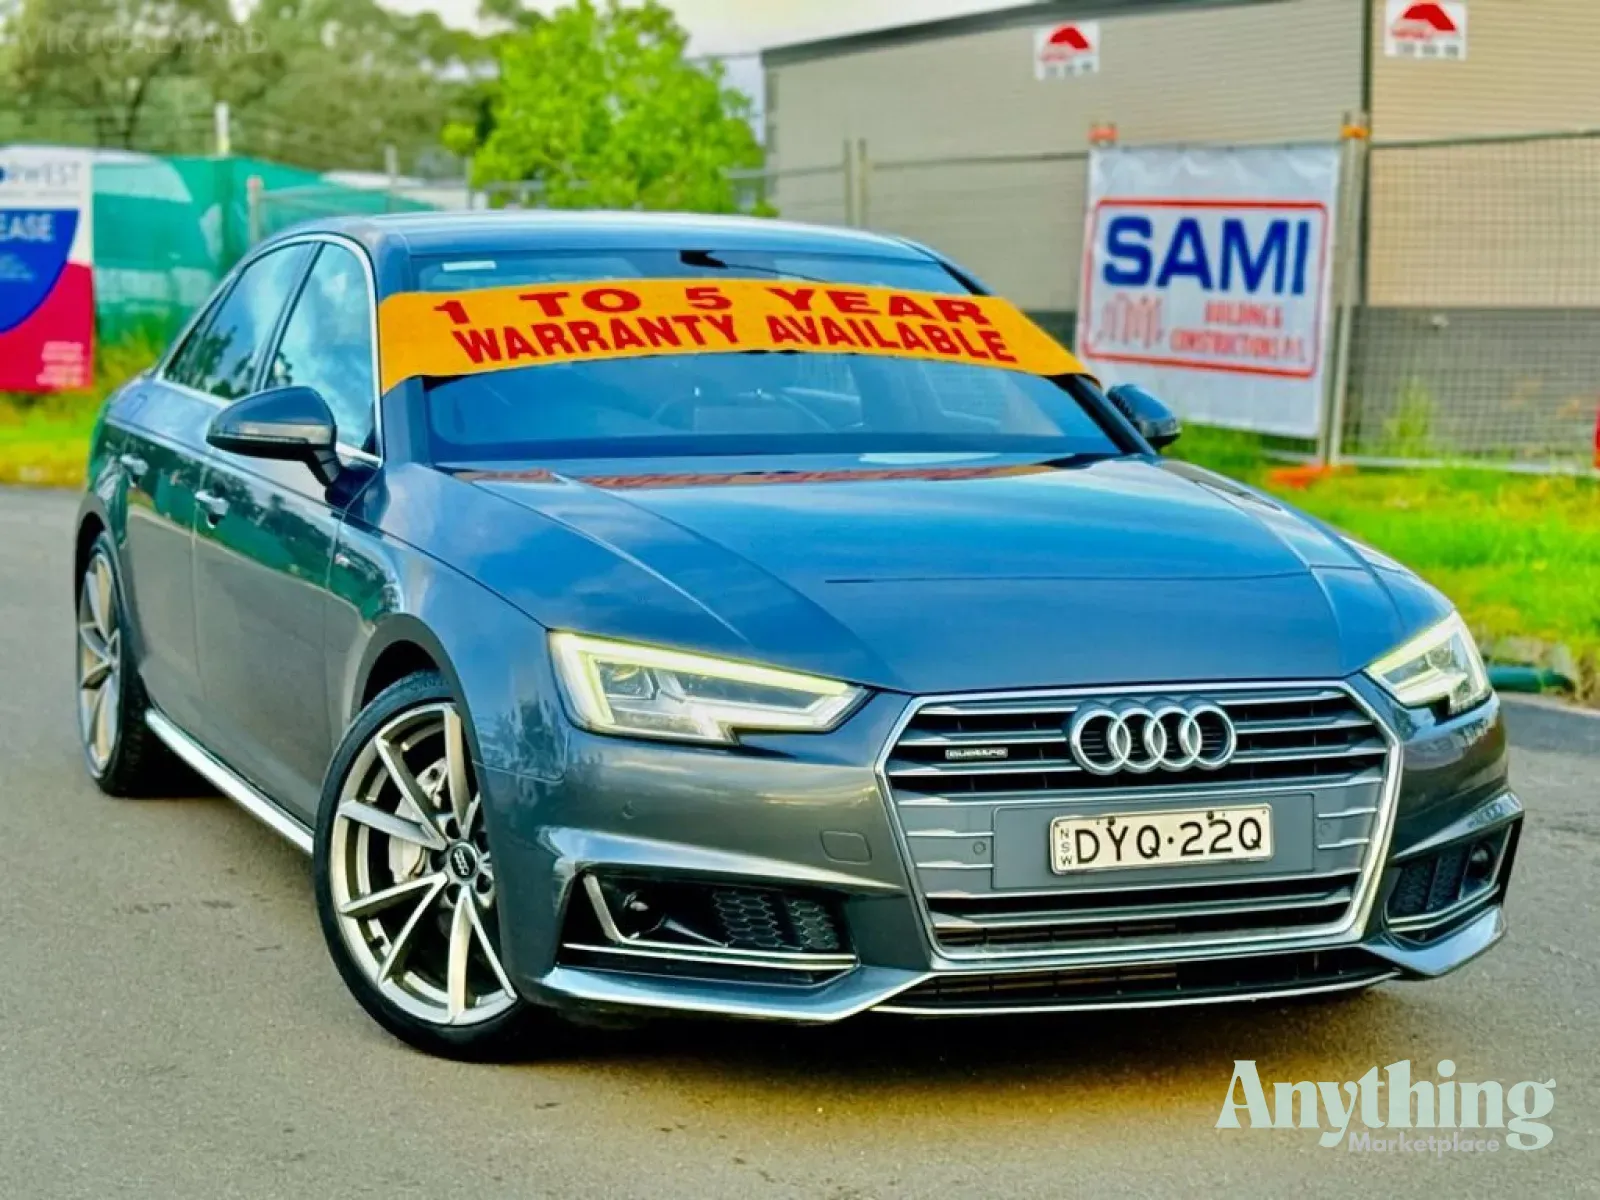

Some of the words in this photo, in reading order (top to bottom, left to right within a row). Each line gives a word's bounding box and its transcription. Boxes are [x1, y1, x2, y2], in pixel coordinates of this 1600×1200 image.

[1103, 216, 1310, 295] SAMI
[433, 300, 470, 324] 1
[518, 288, 642, 317] TO
[685, 287, 733, 310] 5
[765, 287, 992, 325] YEAR
[452, 315, 739, 364] WARRANTY
[766, 315, 1018, 363] AVAILABLE
